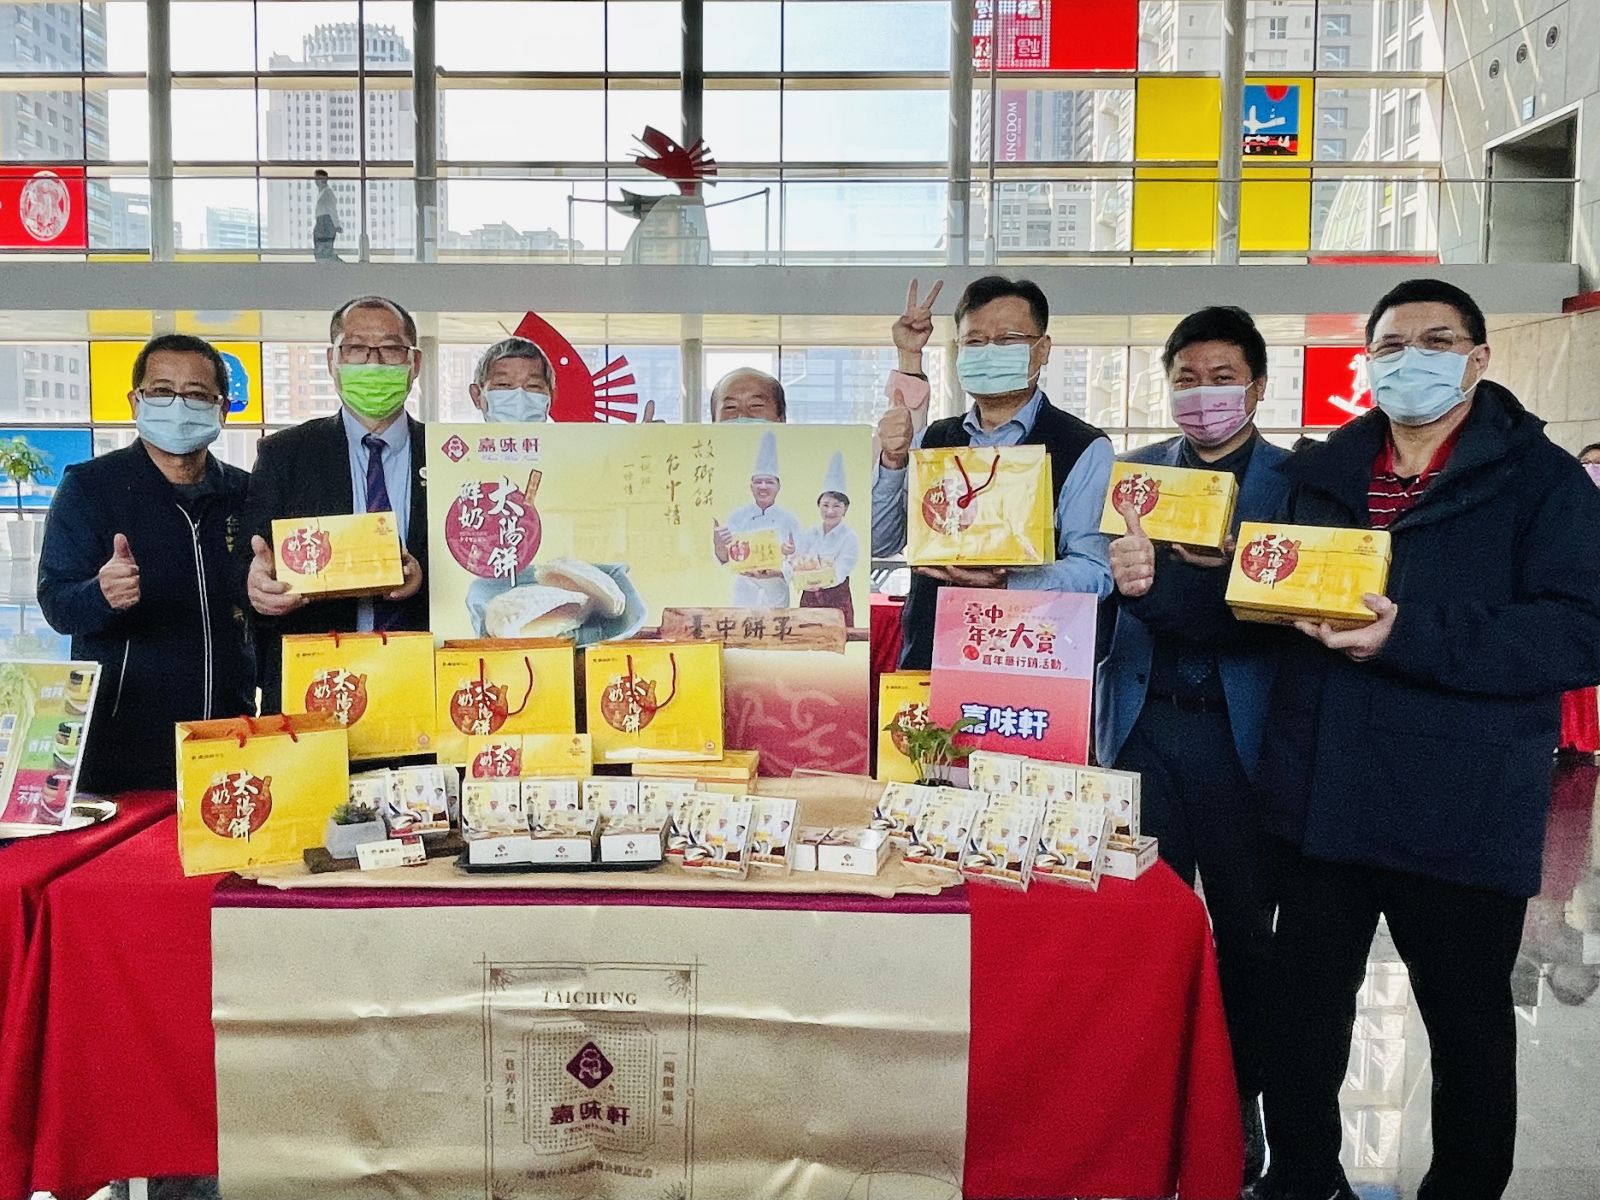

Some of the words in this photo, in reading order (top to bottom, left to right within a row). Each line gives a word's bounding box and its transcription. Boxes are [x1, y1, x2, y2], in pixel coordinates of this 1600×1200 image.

[486, 474, 527, 588] 太陽餅
[964, 602, 1004, 625] 臺中
[959, 702, 1050, 741] 嘉味軒
[541, 990, 638, 1006] TAICHUNG
[549, 1100, 631, 1127] 嘉味軒
